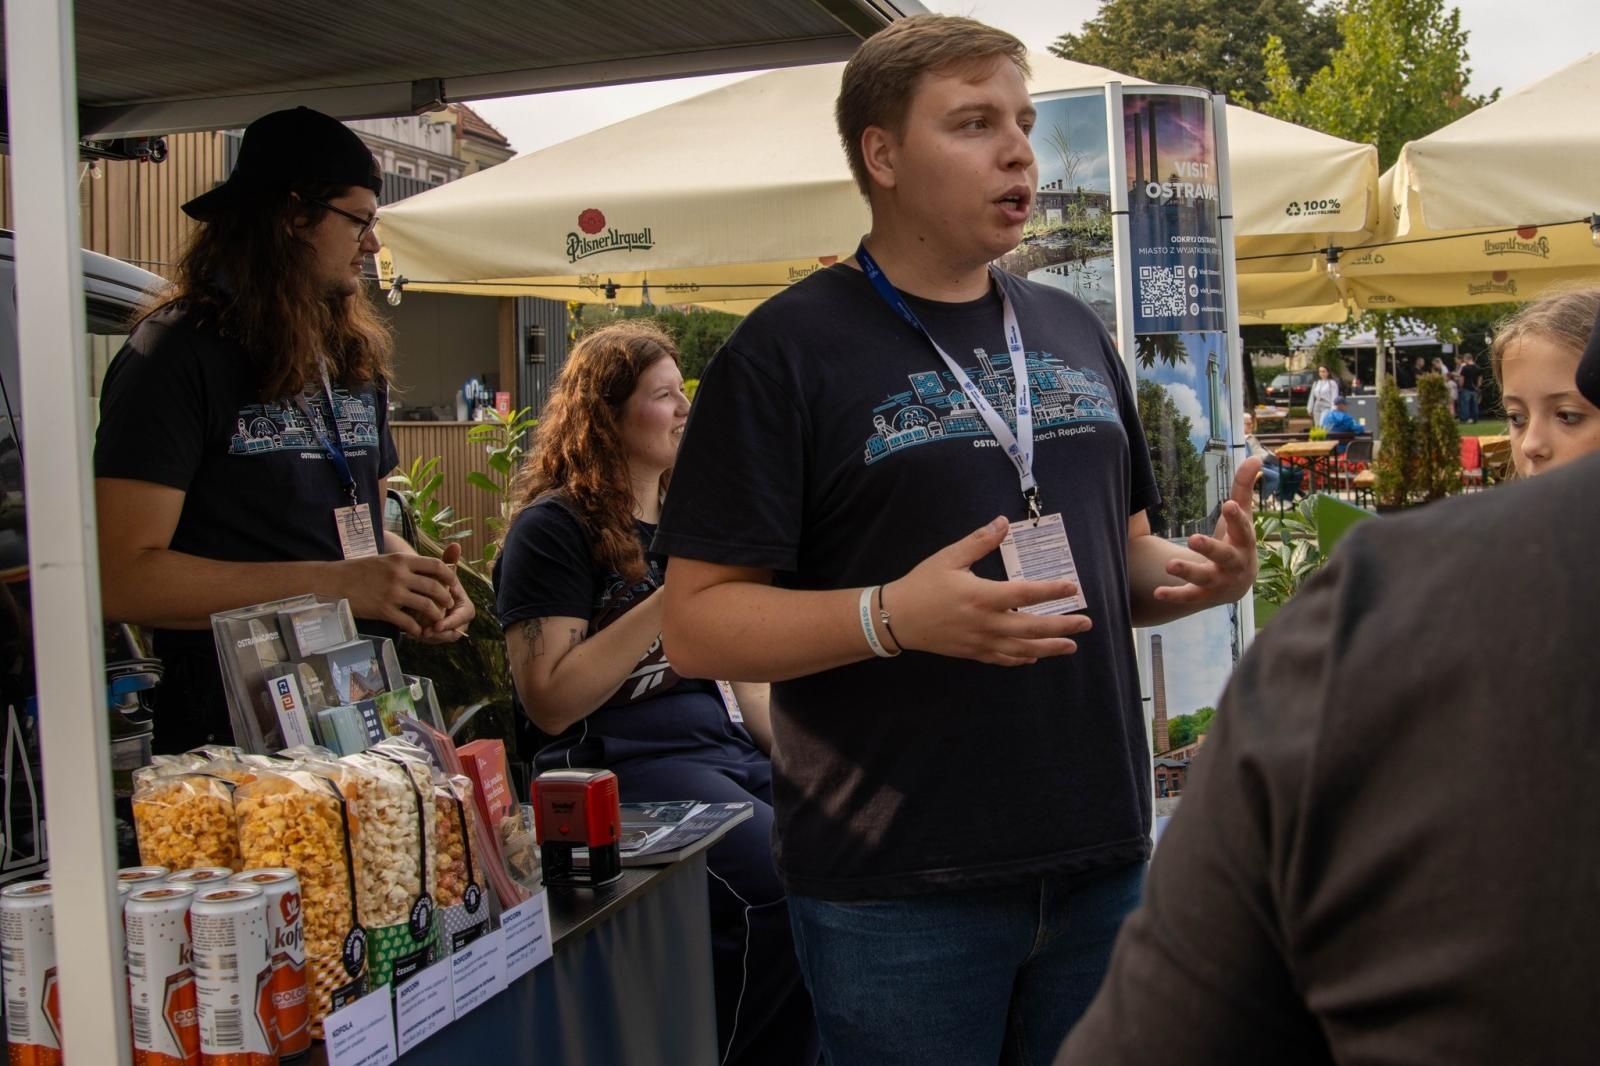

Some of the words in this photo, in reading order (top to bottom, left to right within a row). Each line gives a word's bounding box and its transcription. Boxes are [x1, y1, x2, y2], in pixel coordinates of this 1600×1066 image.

[1174, 161, 1209, 179] VISIT
[1303, 198, 1341, 211] 100%
[566, 232, 610, 264] Pilsner
[608, 227, 653, 253] Urquell
[1171, 235, 1197, 243] ODKRYJ
[1138, 246, 1168, 255] MIASTO
[1170, 246, 1175, 254] Z
[1034, 431, 1056, 443] zech
[1058, 424, 1097, 438] Republic
[343, 449, 368, 459] Republic
[332, 1021, 353, 1038] KOFOLA
